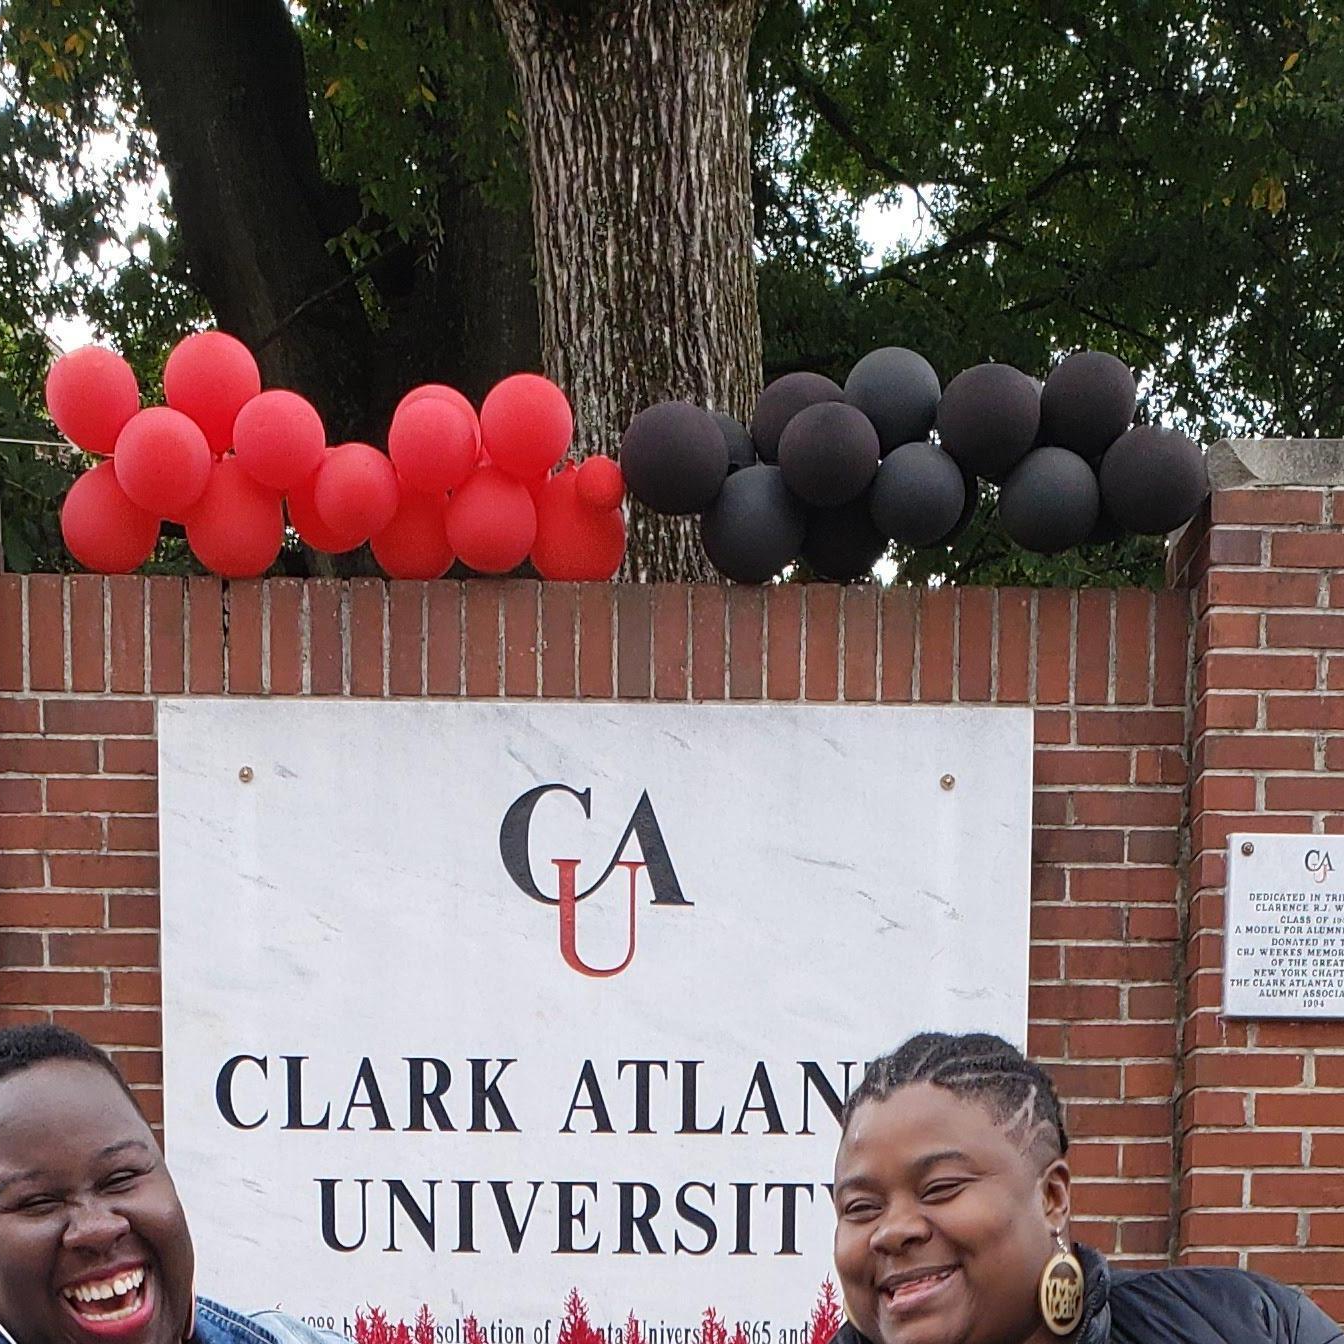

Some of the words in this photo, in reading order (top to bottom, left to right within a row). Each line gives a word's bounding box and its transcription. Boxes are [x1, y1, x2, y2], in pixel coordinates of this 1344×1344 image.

[1249, 893, 1306, 902] DEDICATED
[1310, 893, 1321, 902] IN
[1255, 903, 1309, 912] CLARENCE
[1280, 915, 1312, 924] CLASS
[1316, 916, 1329, 924] OF
[1234, 925, 1242, 934] A
[1245, 925, 1281, 934] MODEL
[1284, 926, 1303, 934] FOR
[1271, 938, 1319, 946] DONATED
[1324, 939, 1336, 947] BY
[1236, 948, 1255, 956] CRJ
[1259, 948, 1303, 956] WEEKES
[1271, 958, 1284, 967] OF
[1288, 958, 1308, 967] THE
[1253, 969, 1276, 977] NEW
[1281, 969, 1308, 977] YORK
[1230, 979, 1250, 987] THE
[1252, 979, 1286, 987] CLARK
[1289, 979, 1334, 988] ATLANTA
[1259, 989, 1298, 998] ALUMNI
[215, 1053, 519, 1135] CLARK
[558, 1059, 872, 1137] ATLAN
[312, 1177, 837, 1258] UNIVERSIT
[534, 1319, 552, 1344] of
